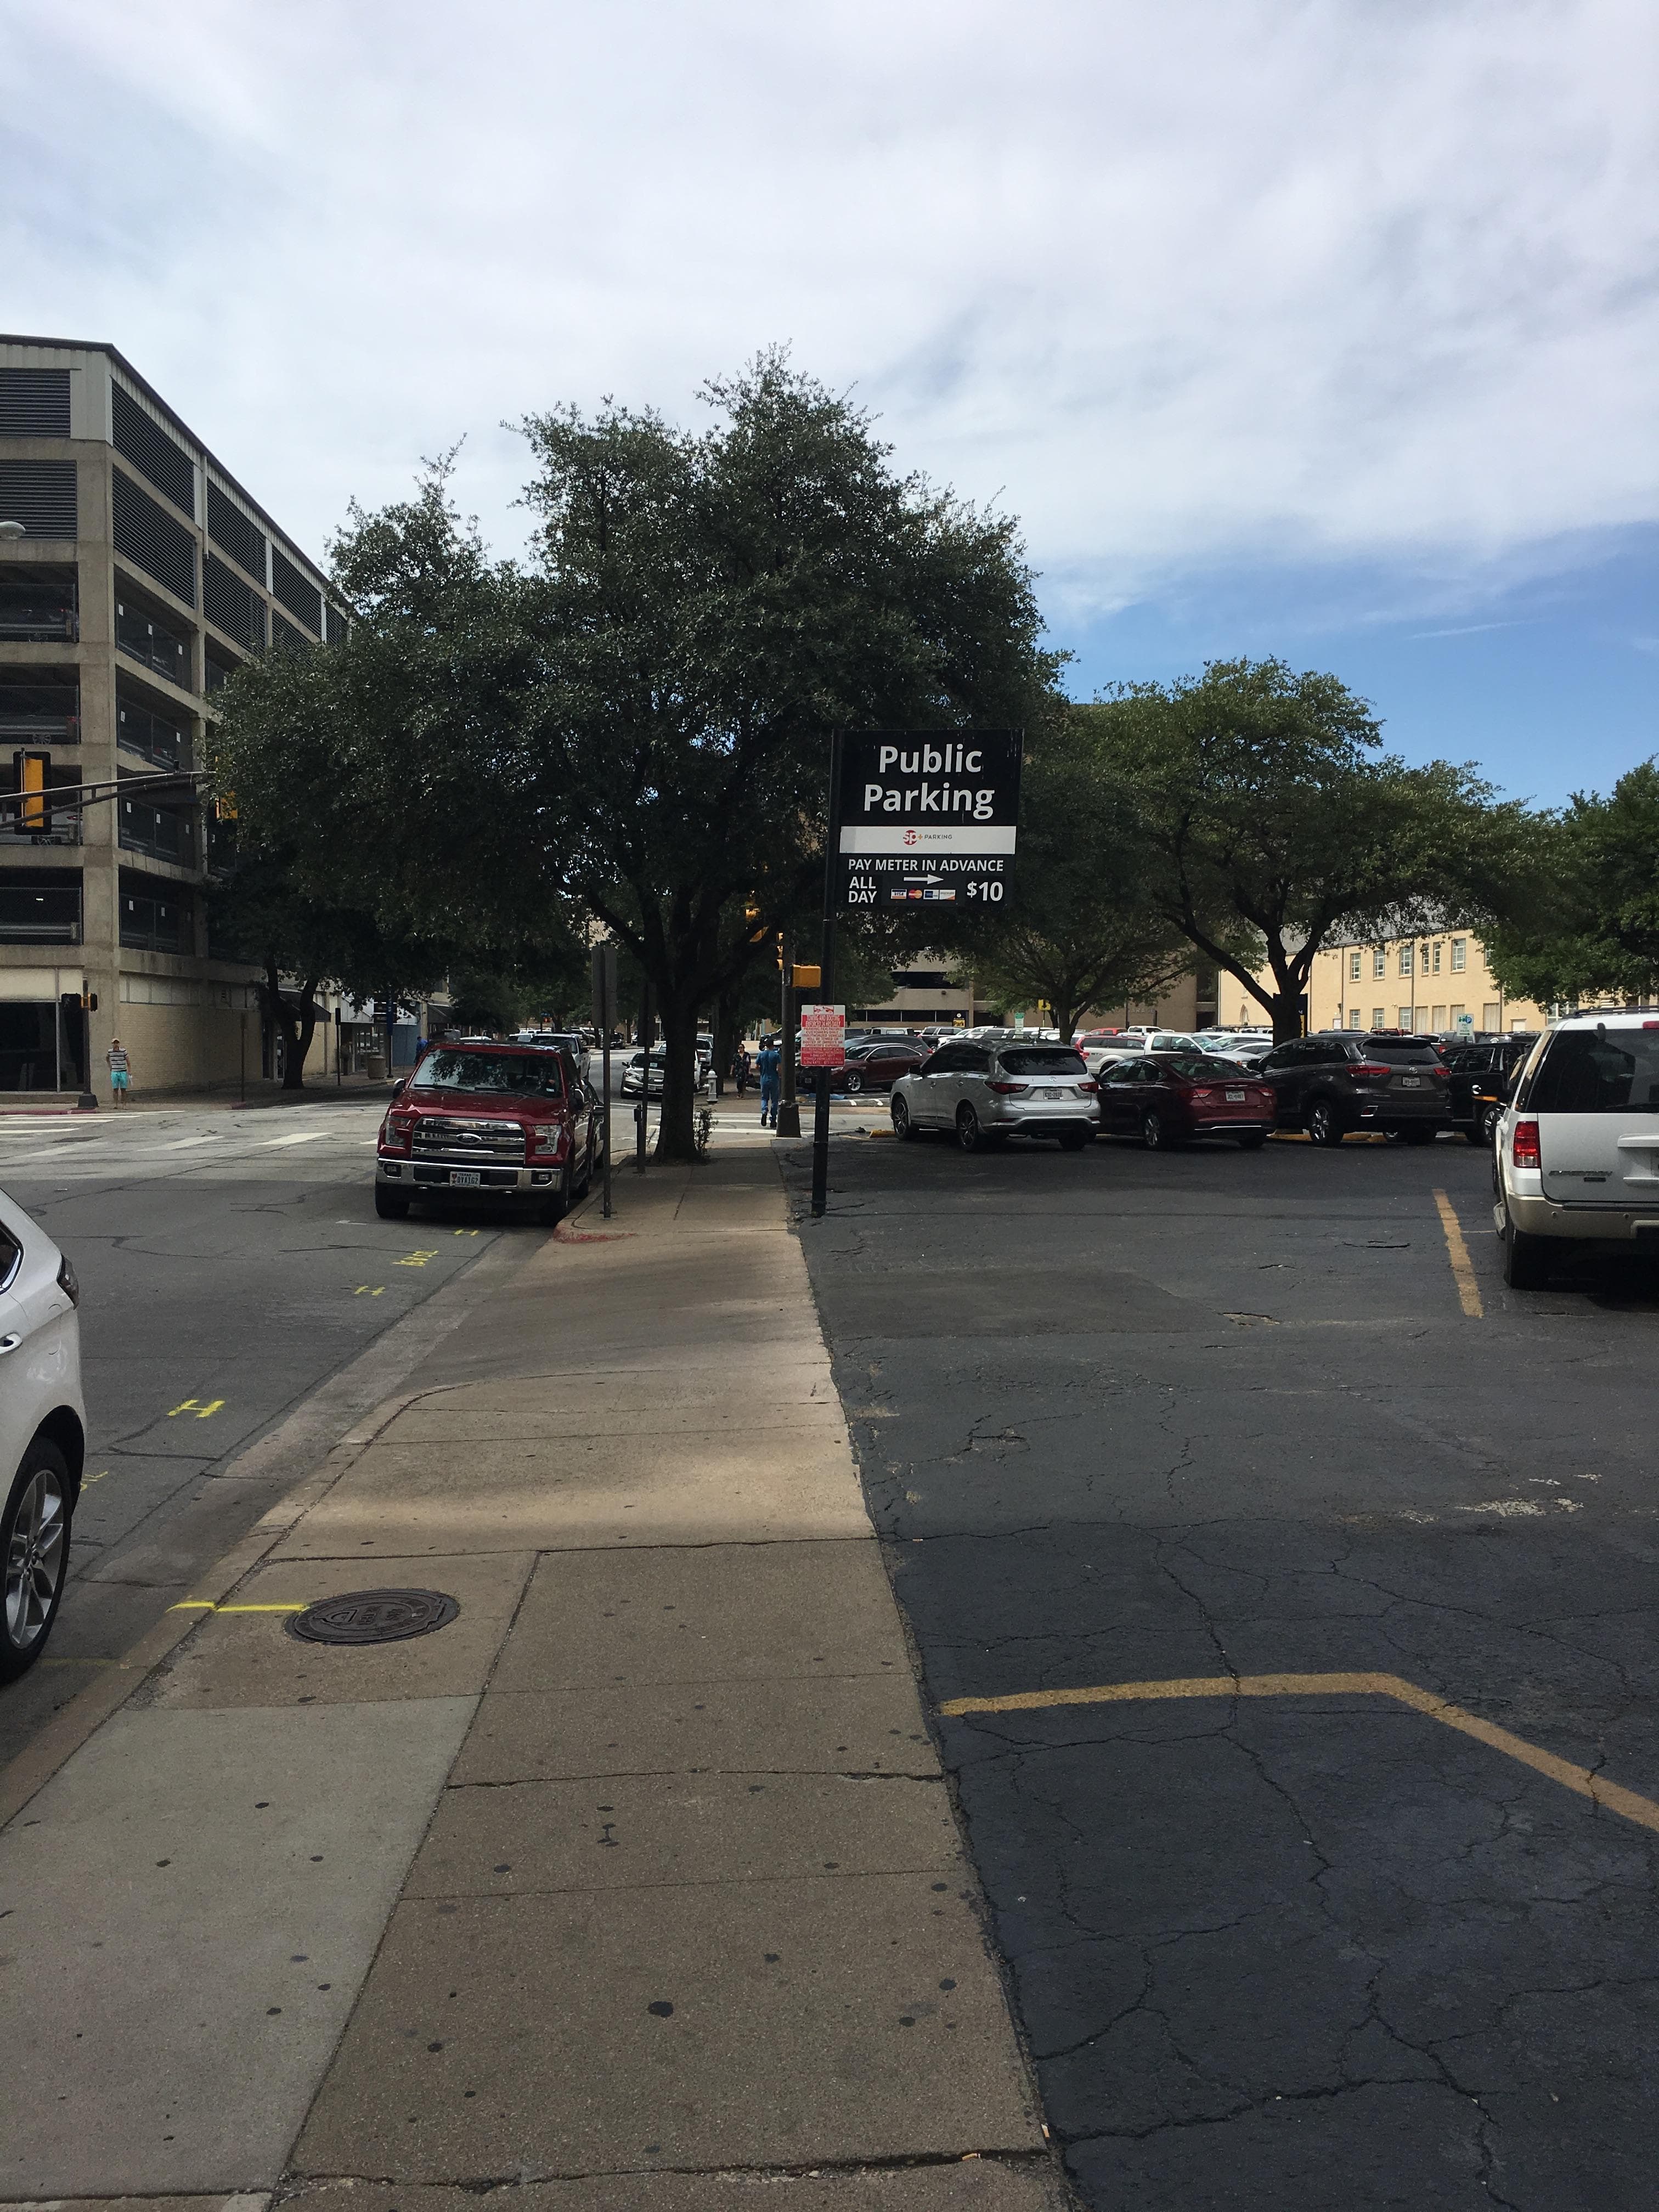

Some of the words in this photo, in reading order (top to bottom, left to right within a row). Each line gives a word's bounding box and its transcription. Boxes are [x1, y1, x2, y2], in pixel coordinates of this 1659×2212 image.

[879, 743, 983, 774] Public
[864, 783, 996, 820] Parking
[848, 859, 872, 871] PAY
[875, 859, 918, 871] METER
[922, 859, 938, 871] IN
[940, 860, 1004, 872] ADVANCE
[848, 890, 877, 903] DAY
[849, 876, 876, 889] ALL
[967, 881, 1003, 901] $10
